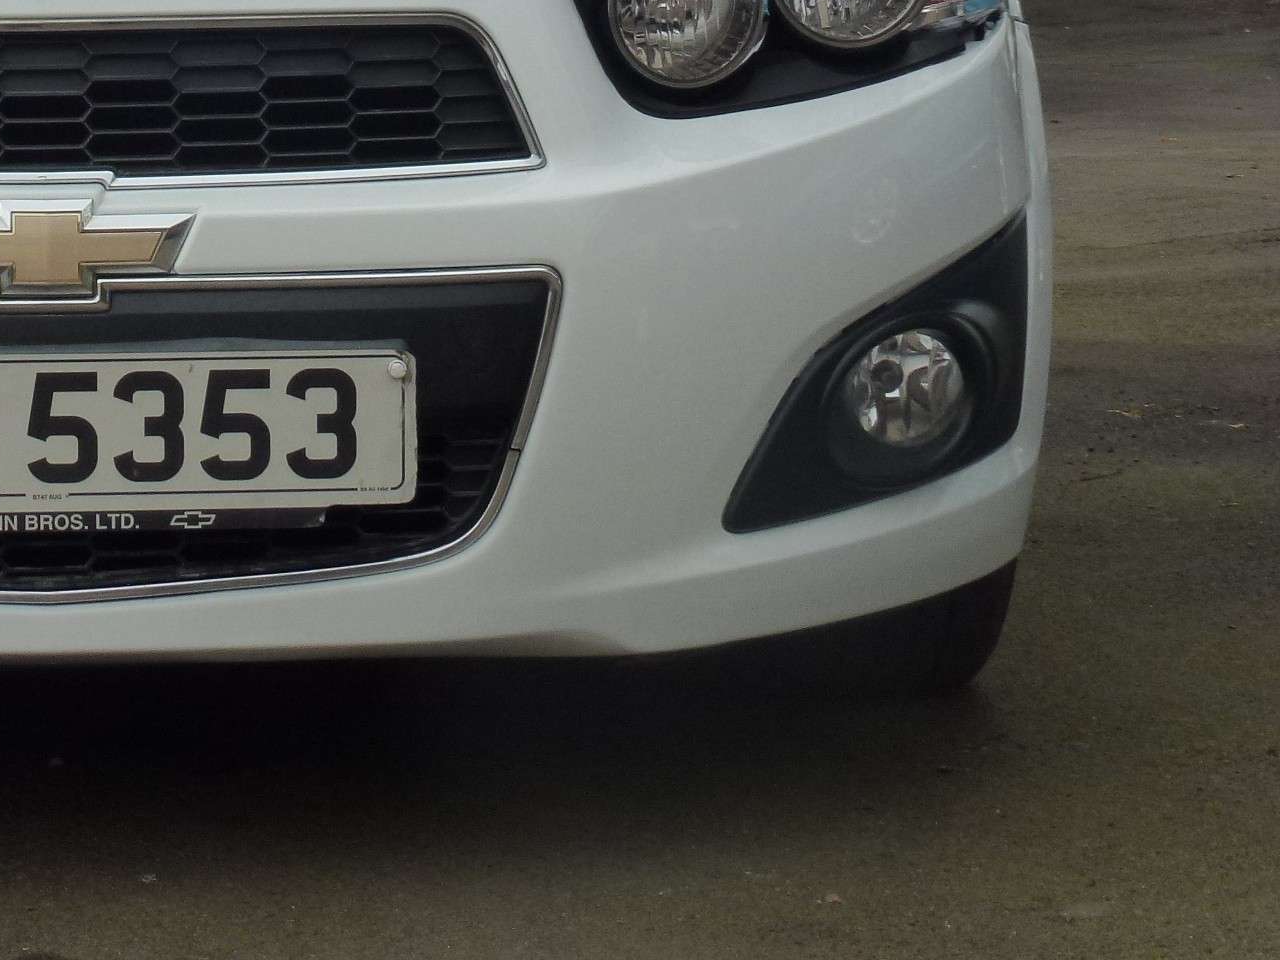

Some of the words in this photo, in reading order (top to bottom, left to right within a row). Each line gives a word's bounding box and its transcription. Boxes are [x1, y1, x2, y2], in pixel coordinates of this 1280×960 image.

[26, 368, 357, 483] 5353
[24, 513, 89, 531] BROS.
[95, 513, 140, 530] LTD.
